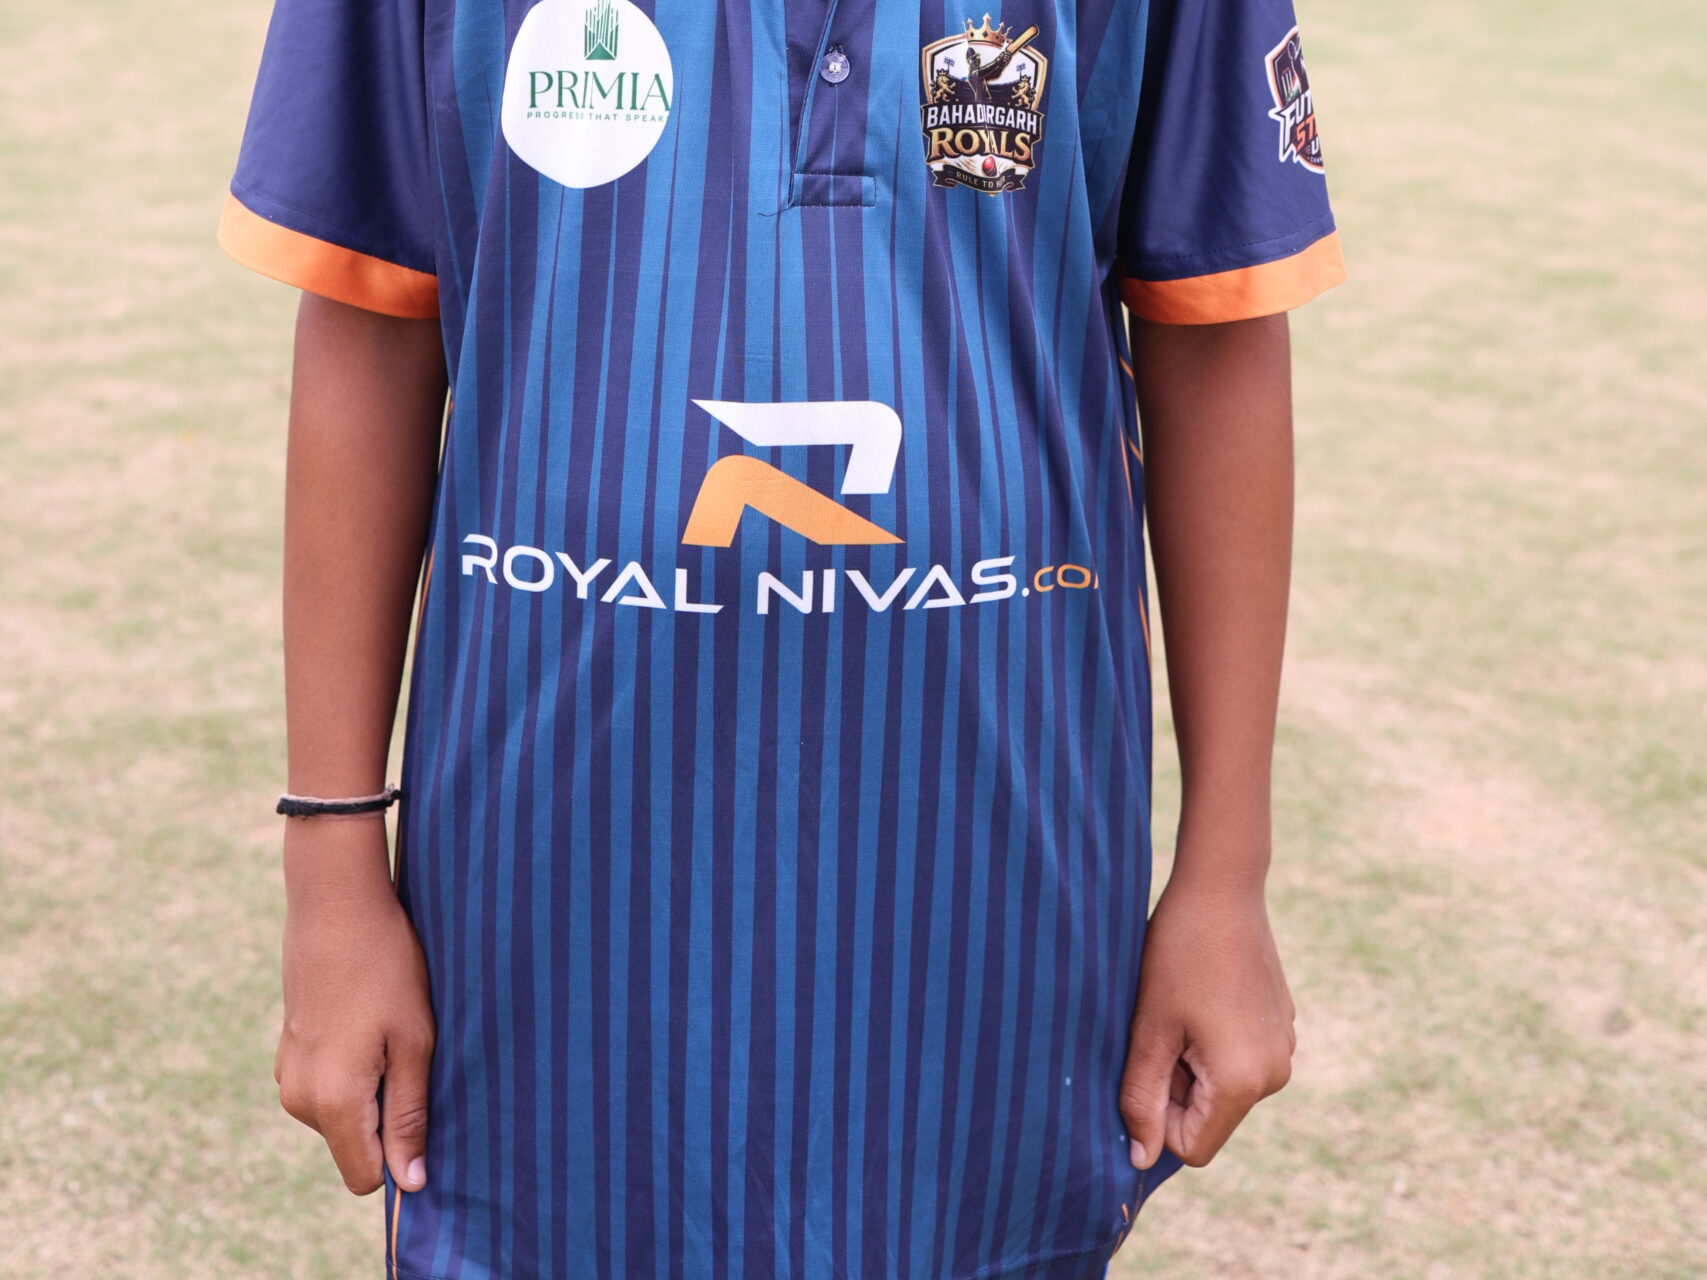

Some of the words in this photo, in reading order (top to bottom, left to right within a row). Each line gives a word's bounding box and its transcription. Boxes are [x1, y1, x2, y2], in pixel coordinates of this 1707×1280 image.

[528, 70, 671, 111] PRIMIA
[589, 113, 619, 121] THAT
[929, 127, 1031, 161] ROYALS
[462, 533, 725, 613] ROYAL
